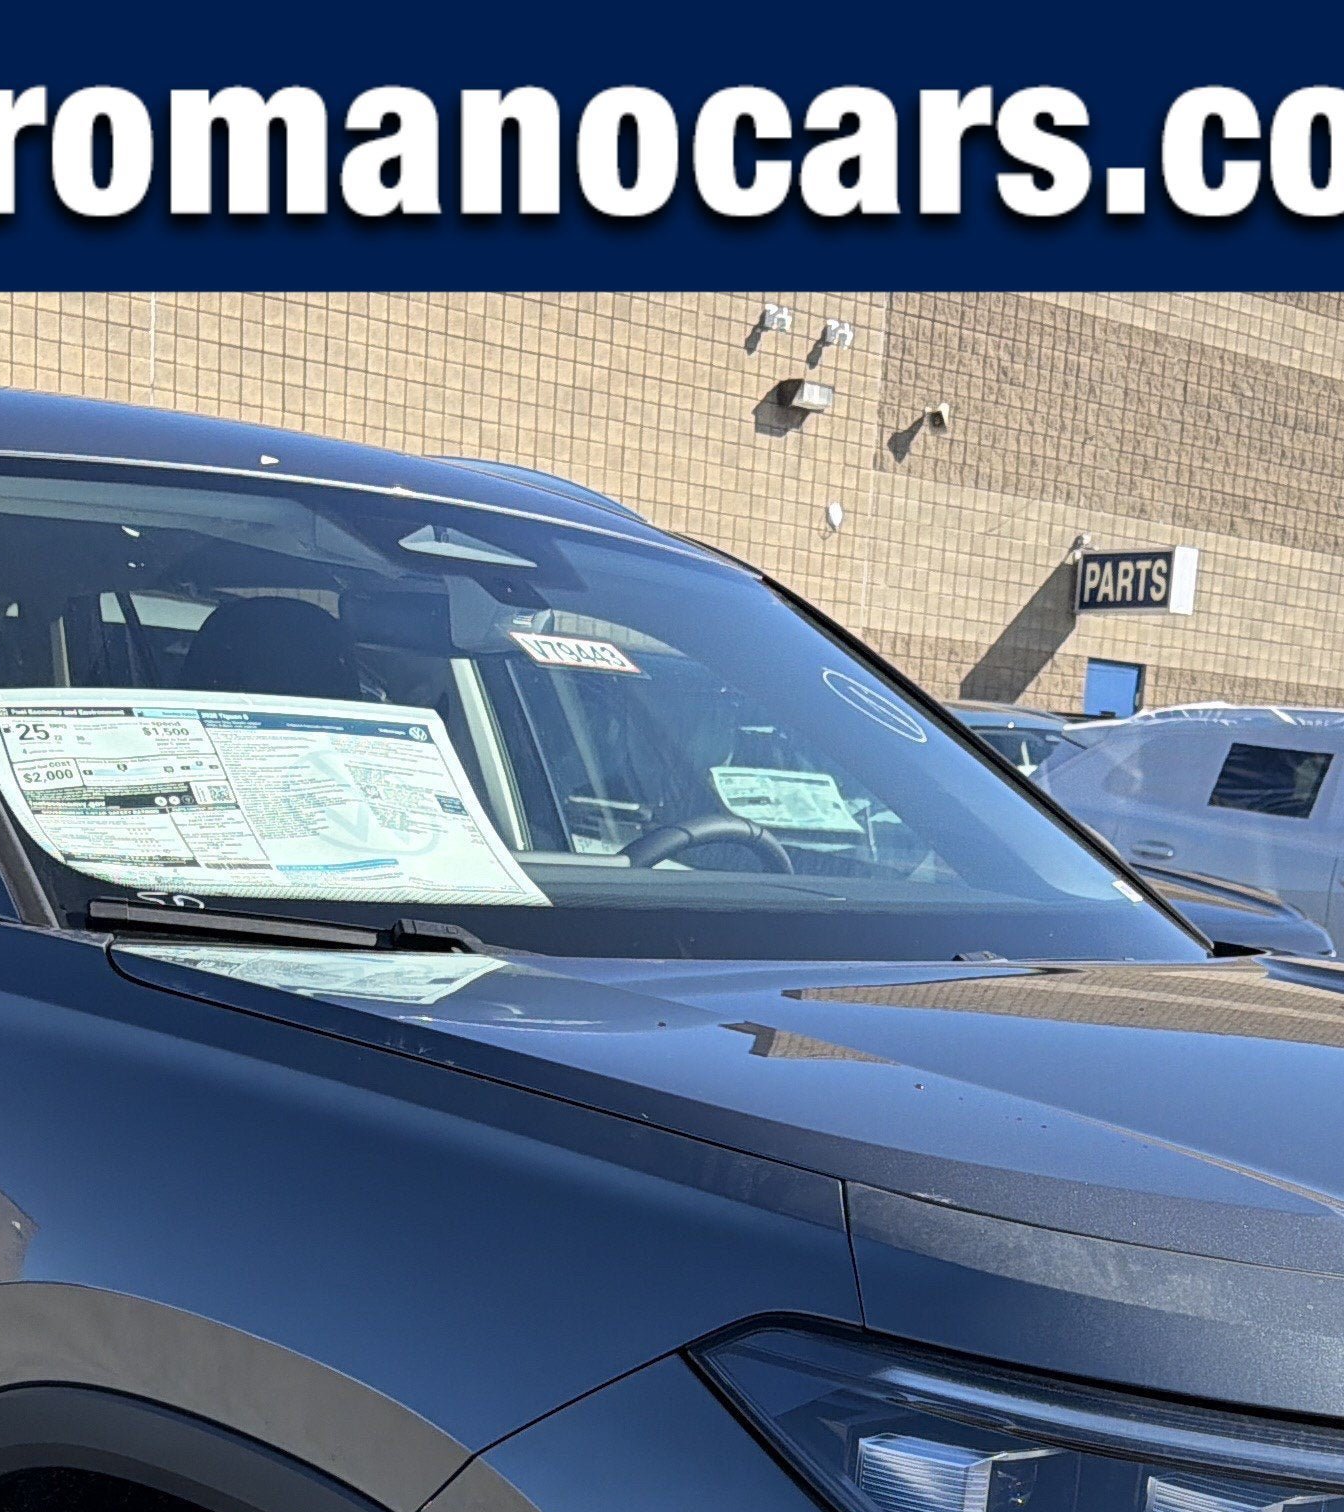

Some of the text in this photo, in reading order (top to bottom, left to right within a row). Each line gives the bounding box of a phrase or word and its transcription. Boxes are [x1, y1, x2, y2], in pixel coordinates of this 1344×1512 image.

[1082, 558, 1168, 603] PARTS
[16, 723, 50, 741] 25
[142, 727, 190, 737] $1,500
[23, 769, 74, 784] $2,000
